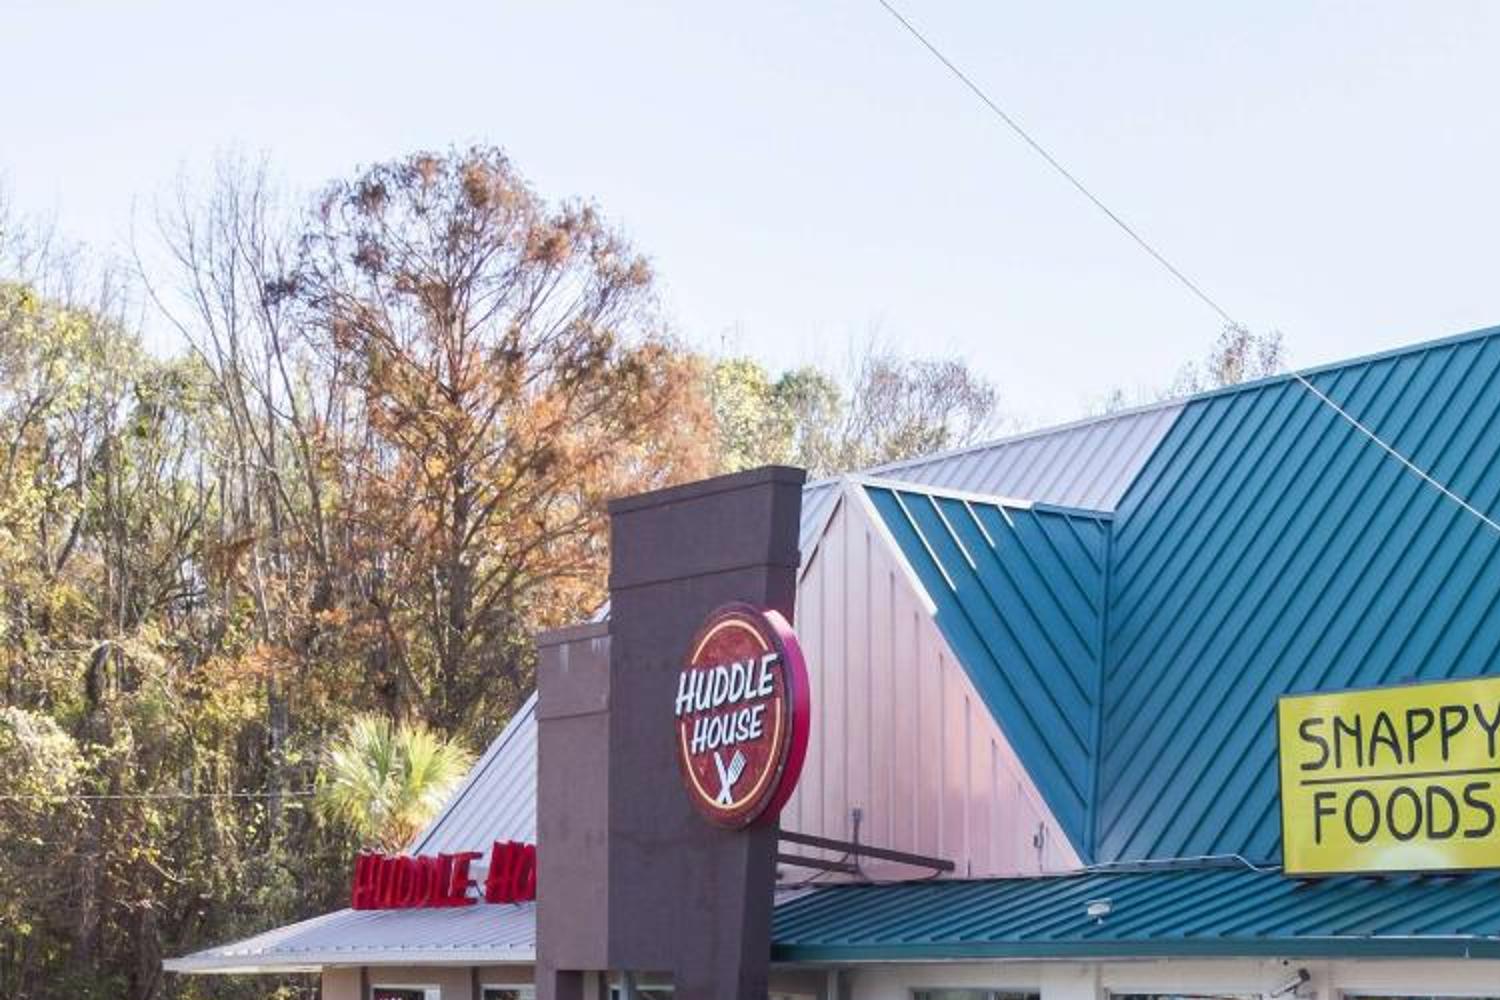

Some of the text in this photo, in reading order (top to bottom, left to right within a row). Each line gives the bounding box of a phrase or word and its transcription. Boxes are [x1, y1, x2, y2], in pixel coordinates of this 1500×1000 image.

[675, 653, 777, 715] HUDDLE
[691, 704, 764, 754] HOUSE
[1313, 782, 1496, 845] FOODS
